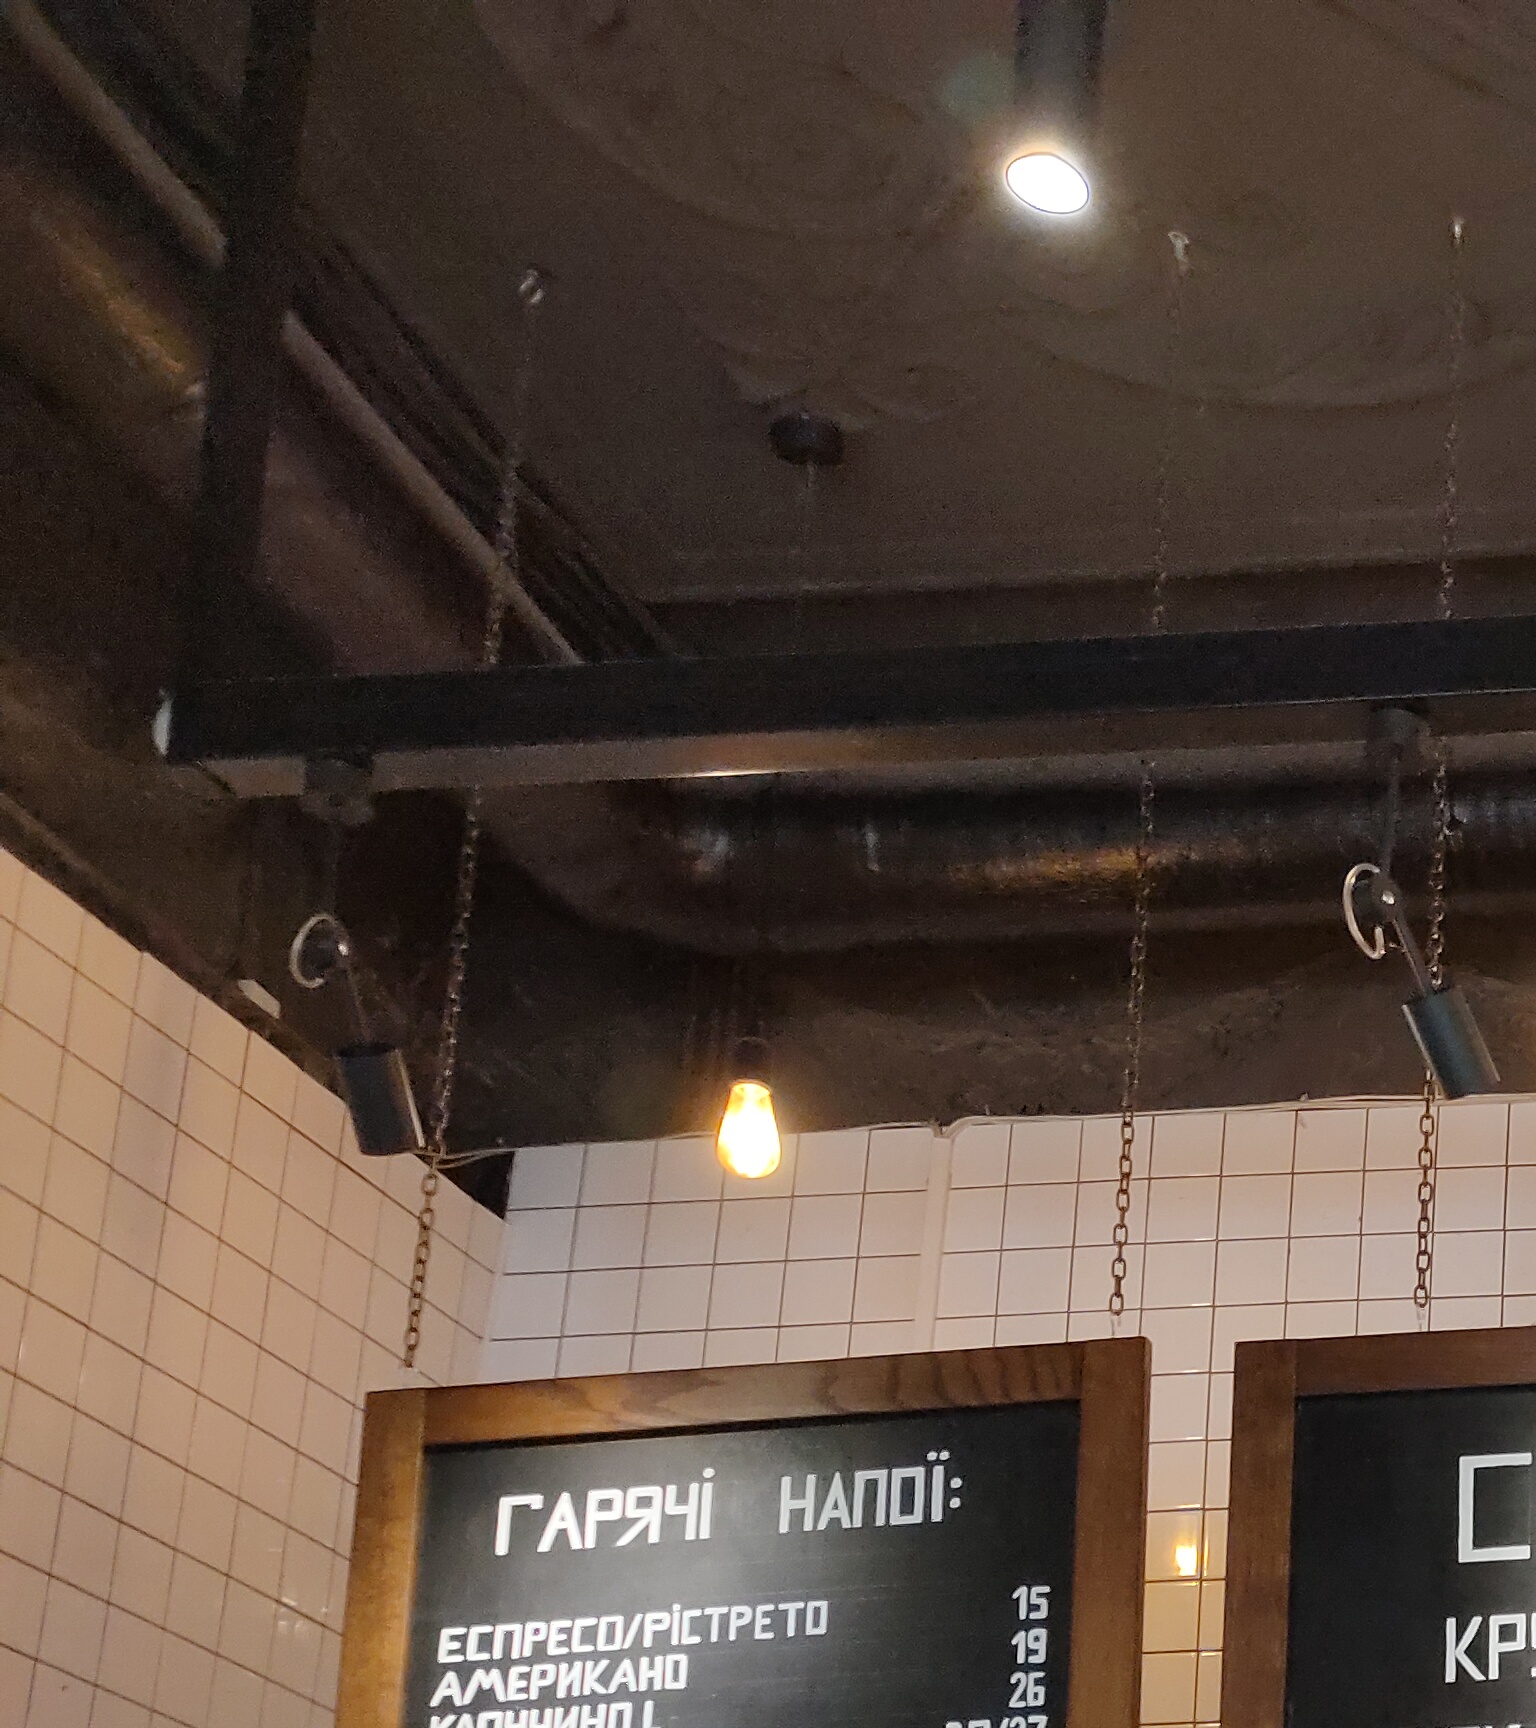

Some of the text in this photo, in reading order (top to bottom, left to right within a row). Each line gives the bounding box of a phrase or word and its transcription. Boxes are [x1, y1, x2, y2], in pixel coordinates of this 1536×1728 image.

[494, 1466, 716, 1557] ГАРЯЧІ
[1011, 1584, 1051, 1621] 15
[428, 1627, 1048, 1708] АМЕРИКАНО 19
[1008, 1671, 1046, 1709] 26
